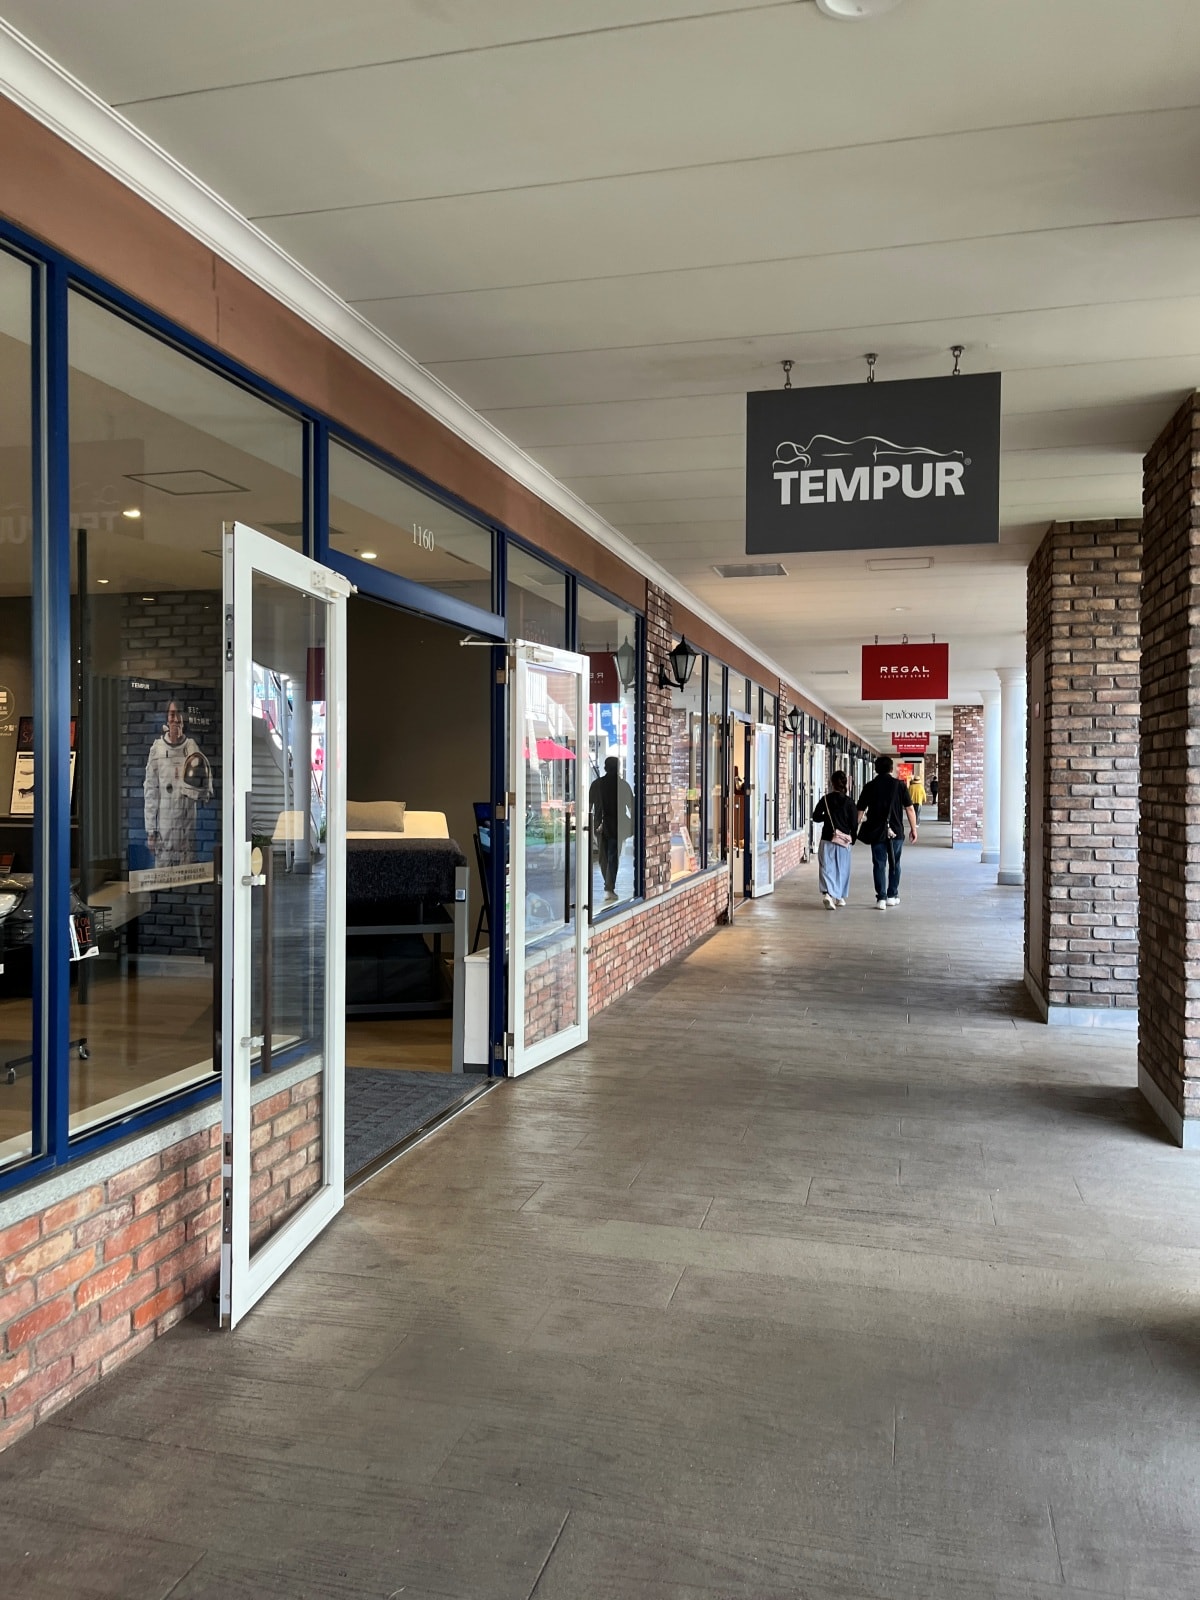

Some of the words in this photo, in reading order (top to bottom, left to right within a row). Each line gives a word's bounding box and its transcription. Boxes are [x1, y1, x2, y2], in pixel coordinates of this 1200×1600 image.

[773, 461, 965, 505] TEMPUR
[412, 523, 435, 552] 1160
[880, 665, 930, 673] REGAL
